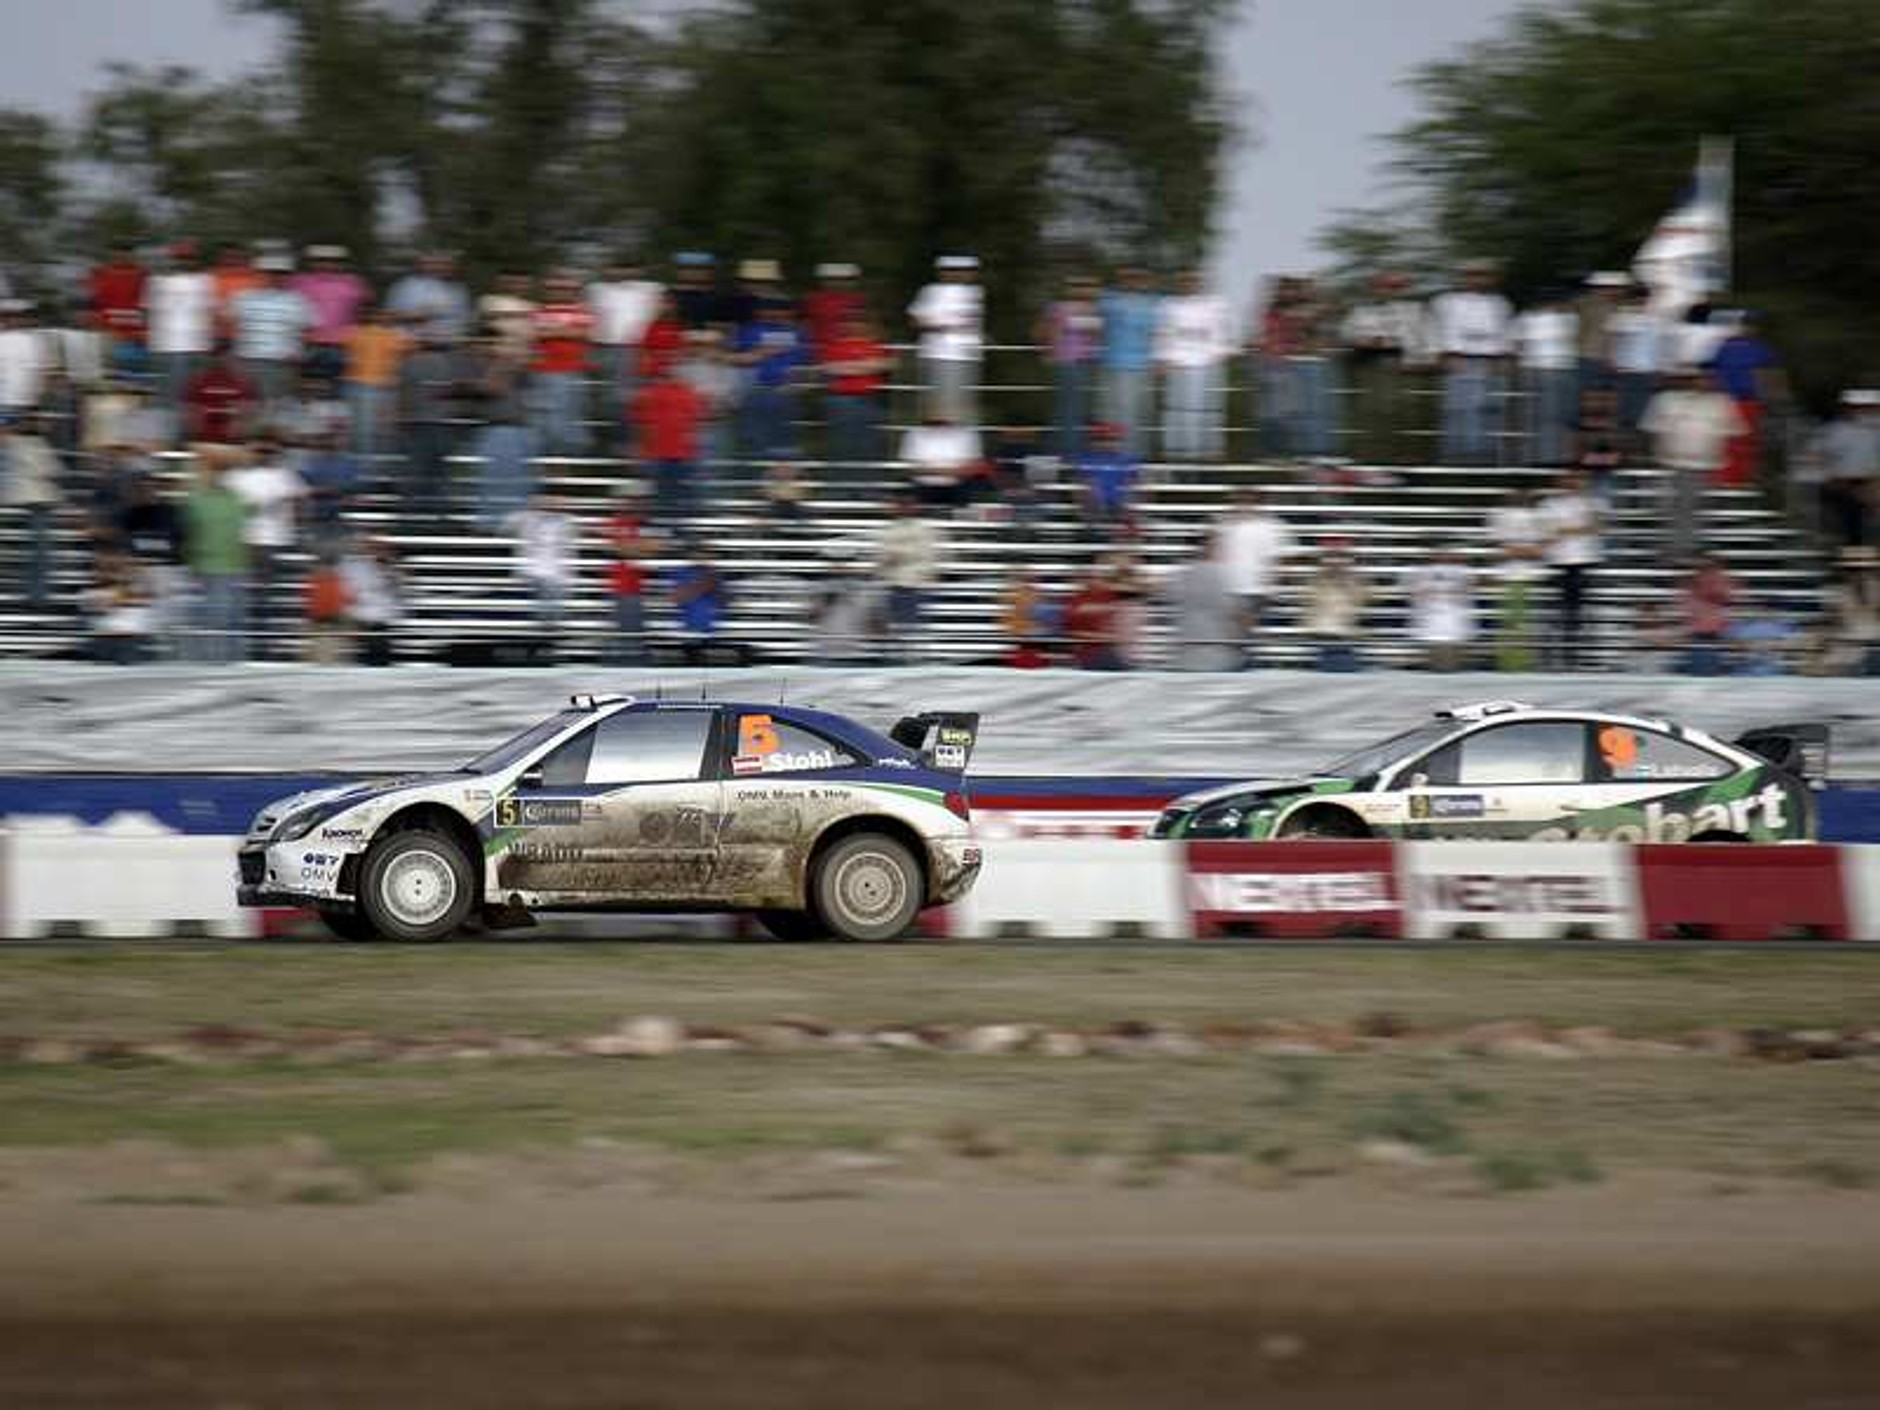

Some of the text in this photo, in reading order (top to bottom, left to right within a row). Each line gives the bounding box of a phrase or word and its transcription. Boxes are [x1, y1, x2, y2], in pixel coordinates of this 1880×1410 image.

[740, 715, 779, 754] 5
[1598, 727, 1637, 766] 9
[766, 749, 834, 772] Stohl
[502, 800, 518, 826] 5
